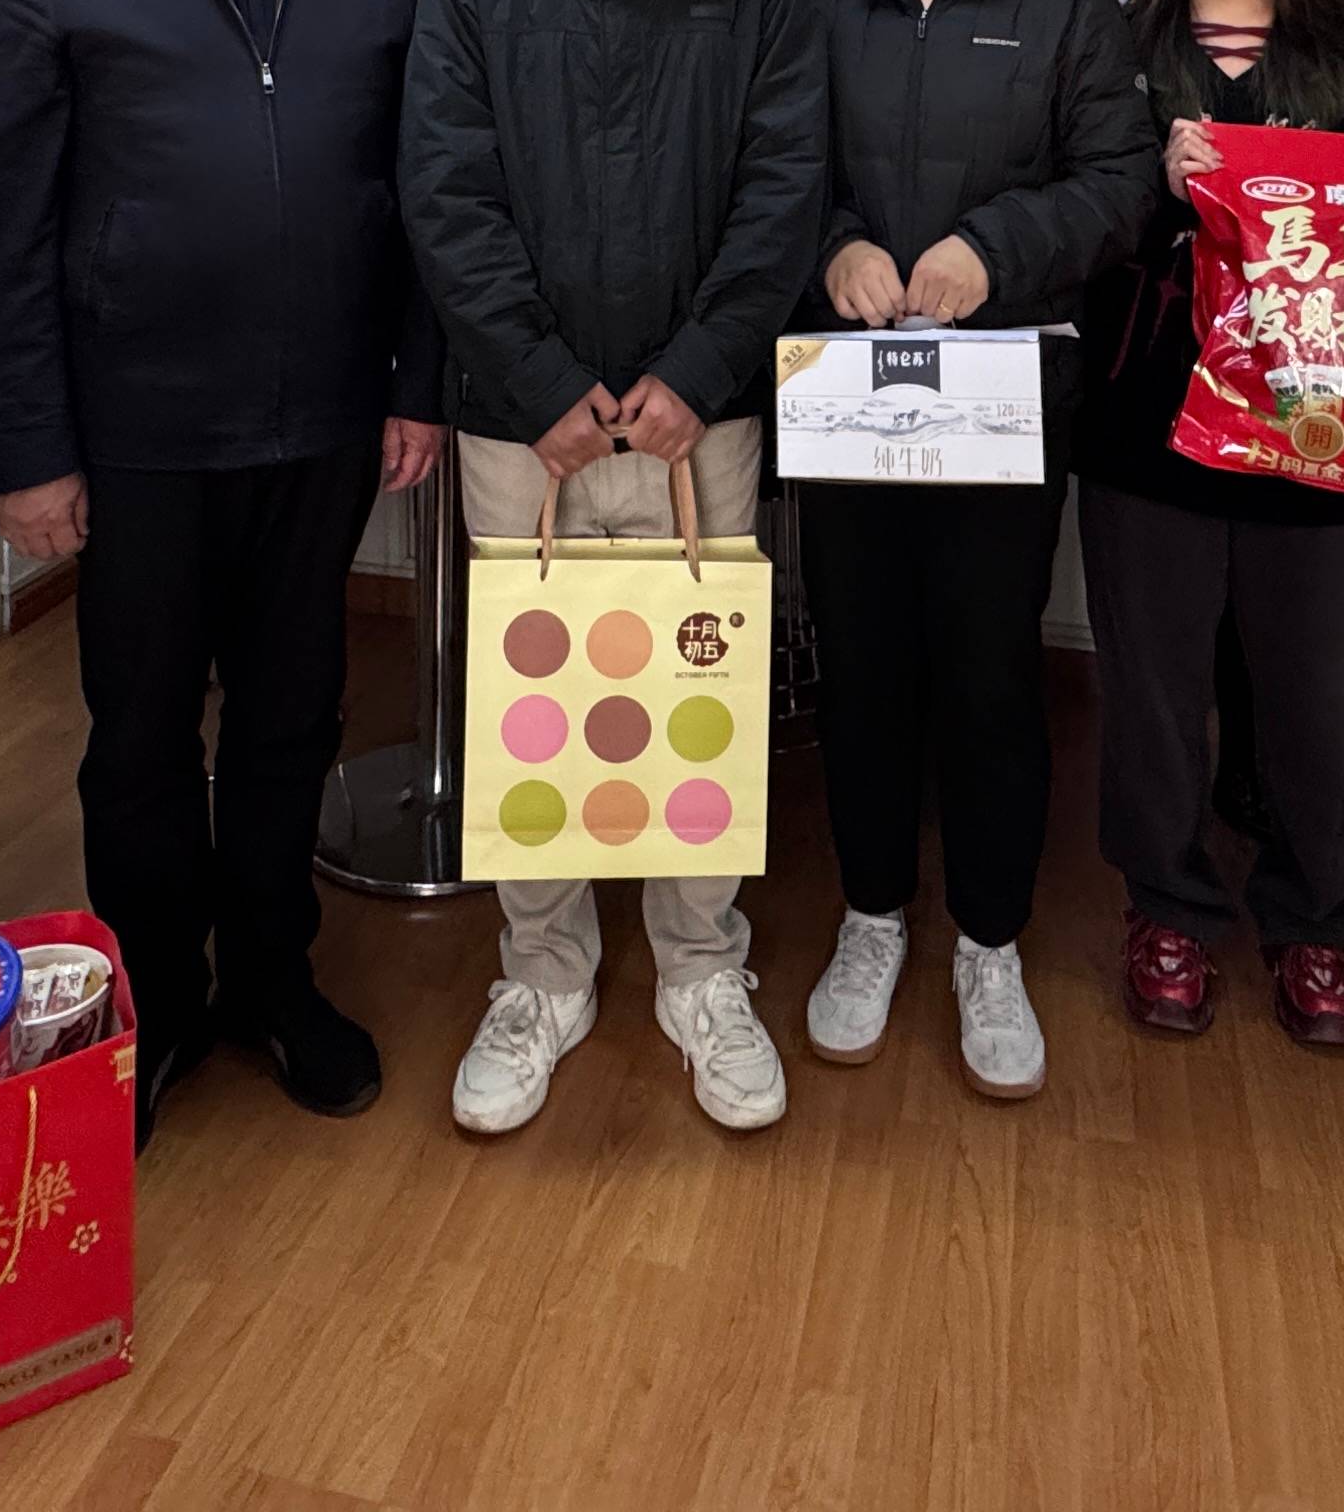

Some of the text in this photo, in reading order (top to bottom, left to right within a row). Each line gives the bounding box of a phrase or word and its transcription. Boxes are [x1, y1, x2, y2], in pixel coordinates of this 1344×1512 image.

[1306, 423, 1333, 450] 開
[873, 445, 943, 477] 纯牛奶
[682, 618, 717, 640] 十月
[684, 640, 719, 664] 初五
[675, 671, 730, 679] OCTOBER FIFTH
